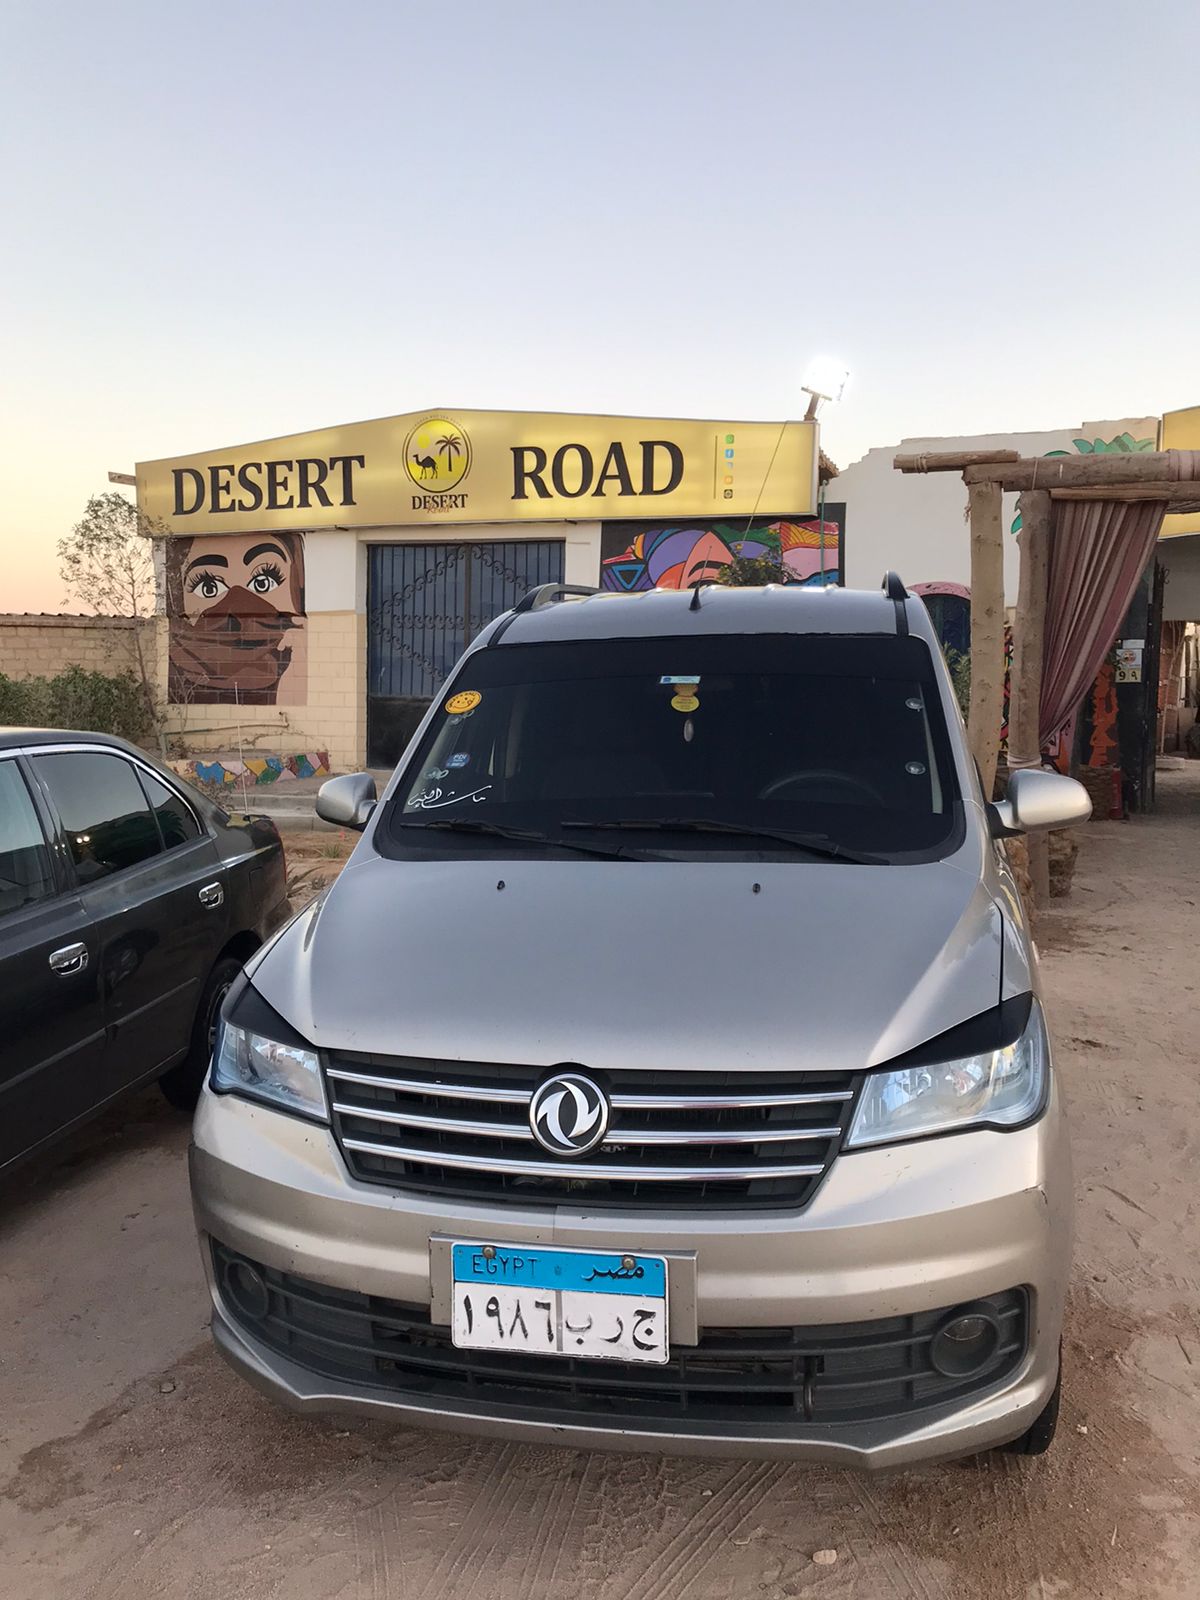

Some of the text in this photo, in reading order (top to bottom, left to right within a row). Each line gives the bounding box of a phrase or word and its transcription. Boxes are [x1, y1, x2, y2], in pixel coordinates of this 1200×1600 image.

[172, 440, 685, 516] DESERT ROAD
[411, 493, 469, 509] DESERT
[472, 1253, 539, 1278] EGYPT
[580, 1262, 645, 1282] مصر
[462, 1293, 555, 1344] ١٩٨٦
